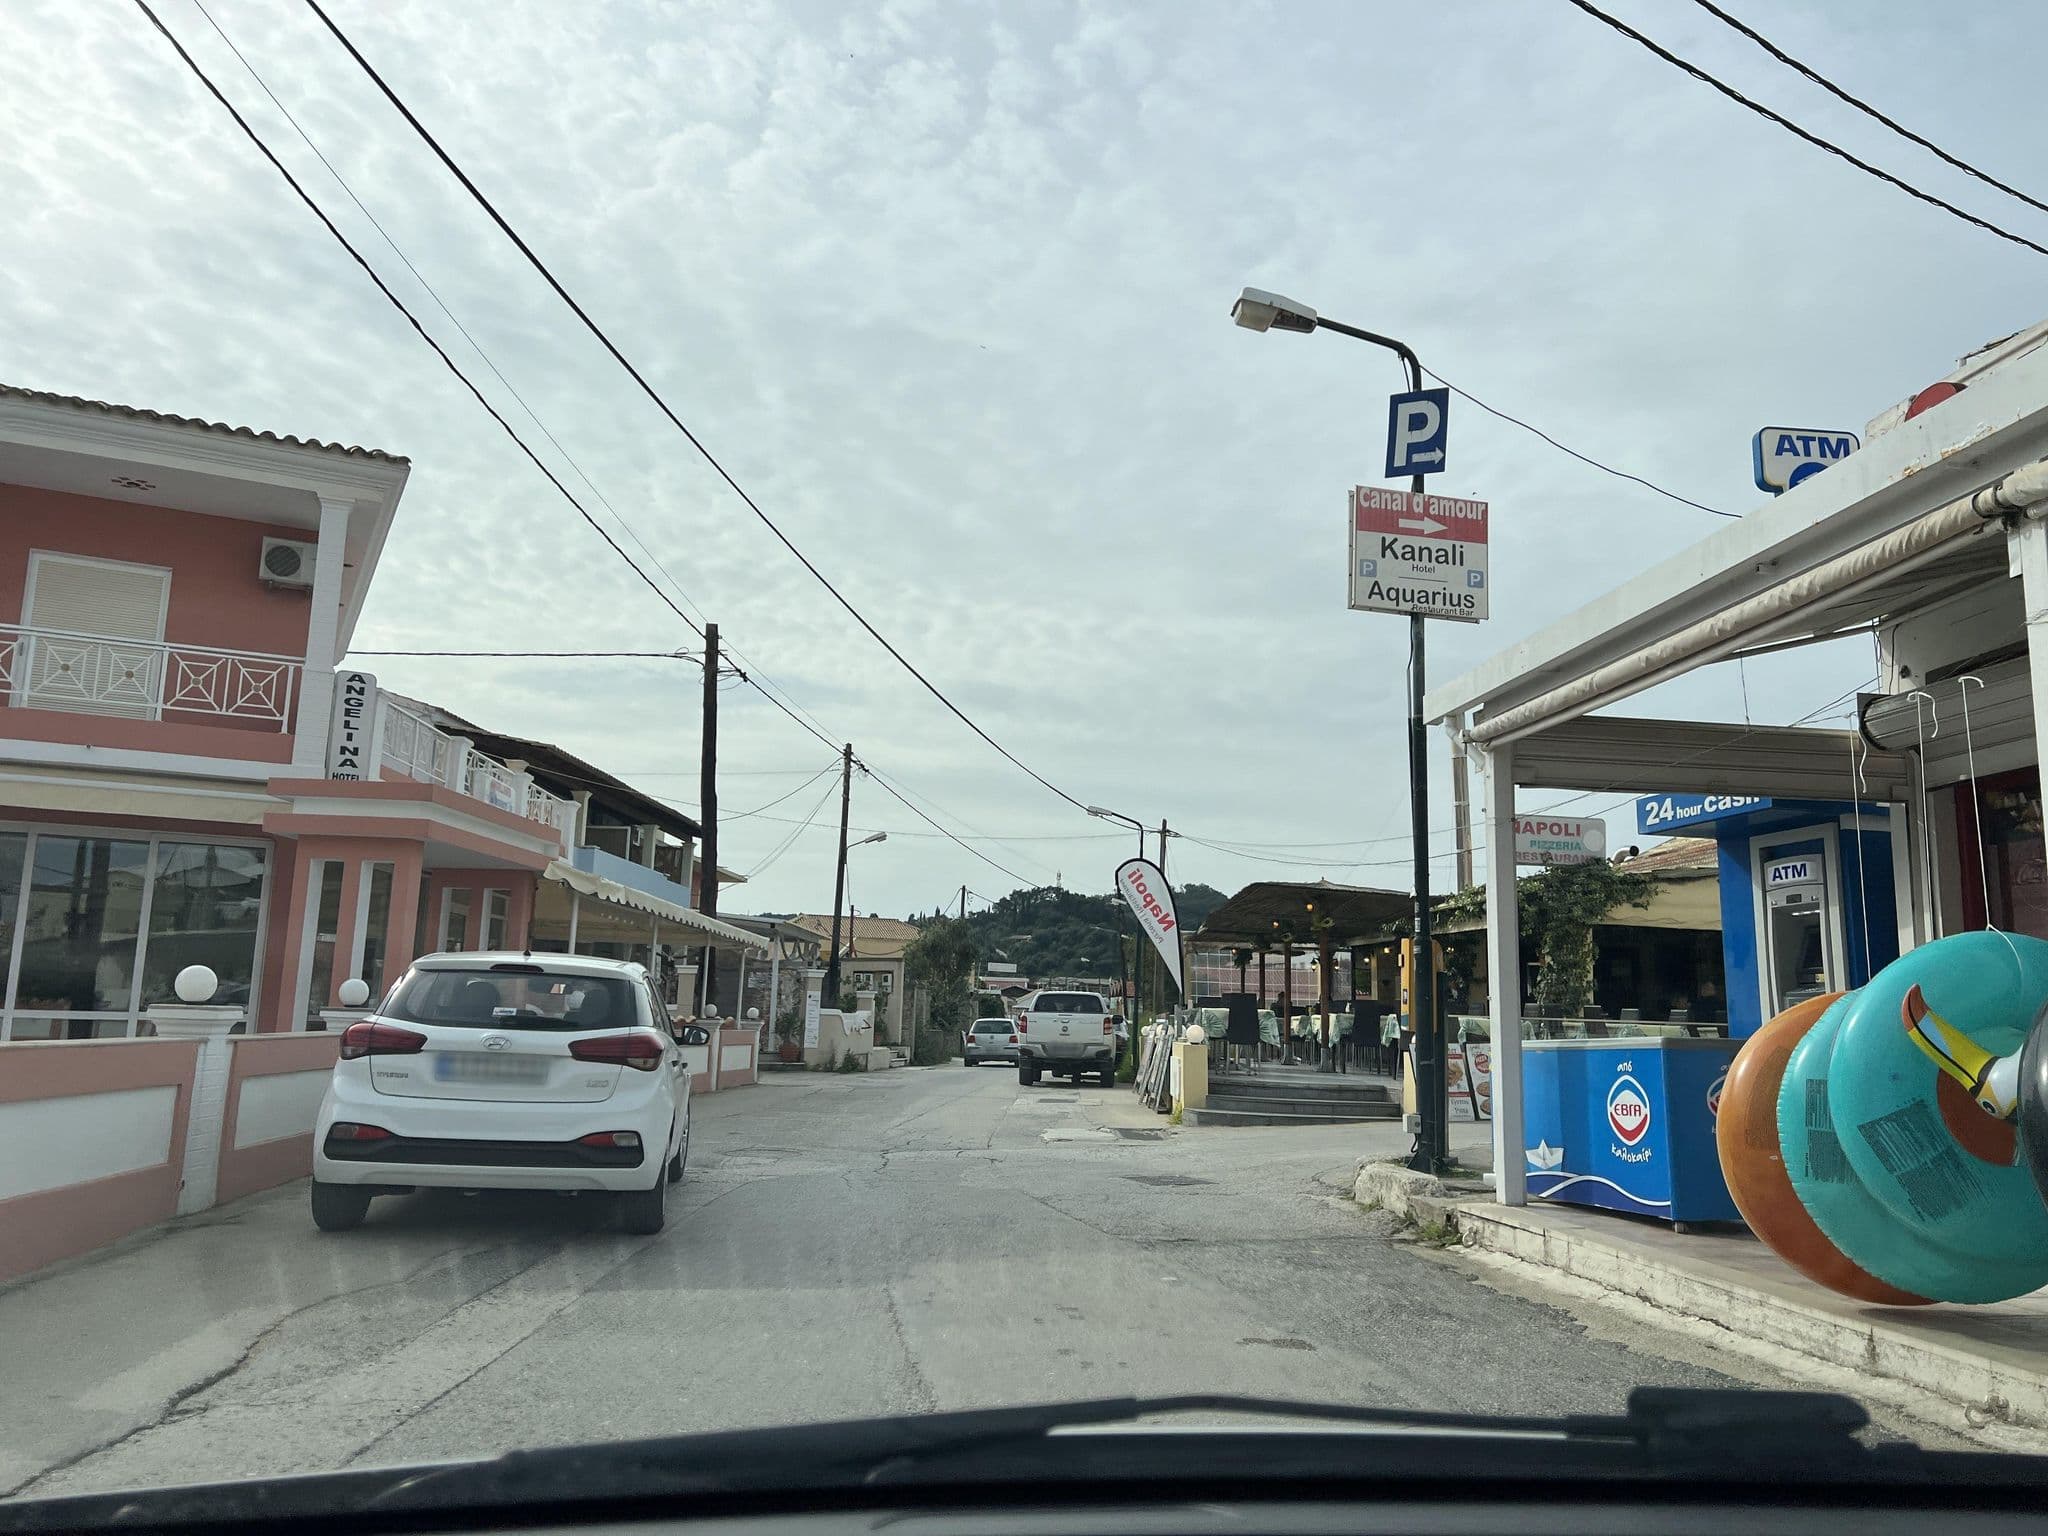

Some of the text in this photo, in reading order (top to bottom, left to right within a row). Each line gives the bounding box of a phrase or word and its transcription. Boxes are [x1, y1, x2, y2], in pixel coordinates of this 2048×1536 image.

[1394, 400, 1440, 467] P
[1775, 434, 1851, 459] ATM
[1360, 487, 1486, 520] Canal d'amour
[1381, 536, 1464, 567] Kanali
[1412, 563, 1436, 574] Hotel
[1367, 580, 1476, 609] Aquarius
[1411, 604, 1474, 617] Restaurant Bar
[338, 673, 366, 768] ANGELINA
[1645, 797, 1674, 826] 24
[1676, 804, 1703, 820] hour
[1529, 839, 1582, 852] PIZZERIA
[1772, 862, 1808, 882] ATM
[1614, 1103, 1642, 1117] ΕΒΓΑ
